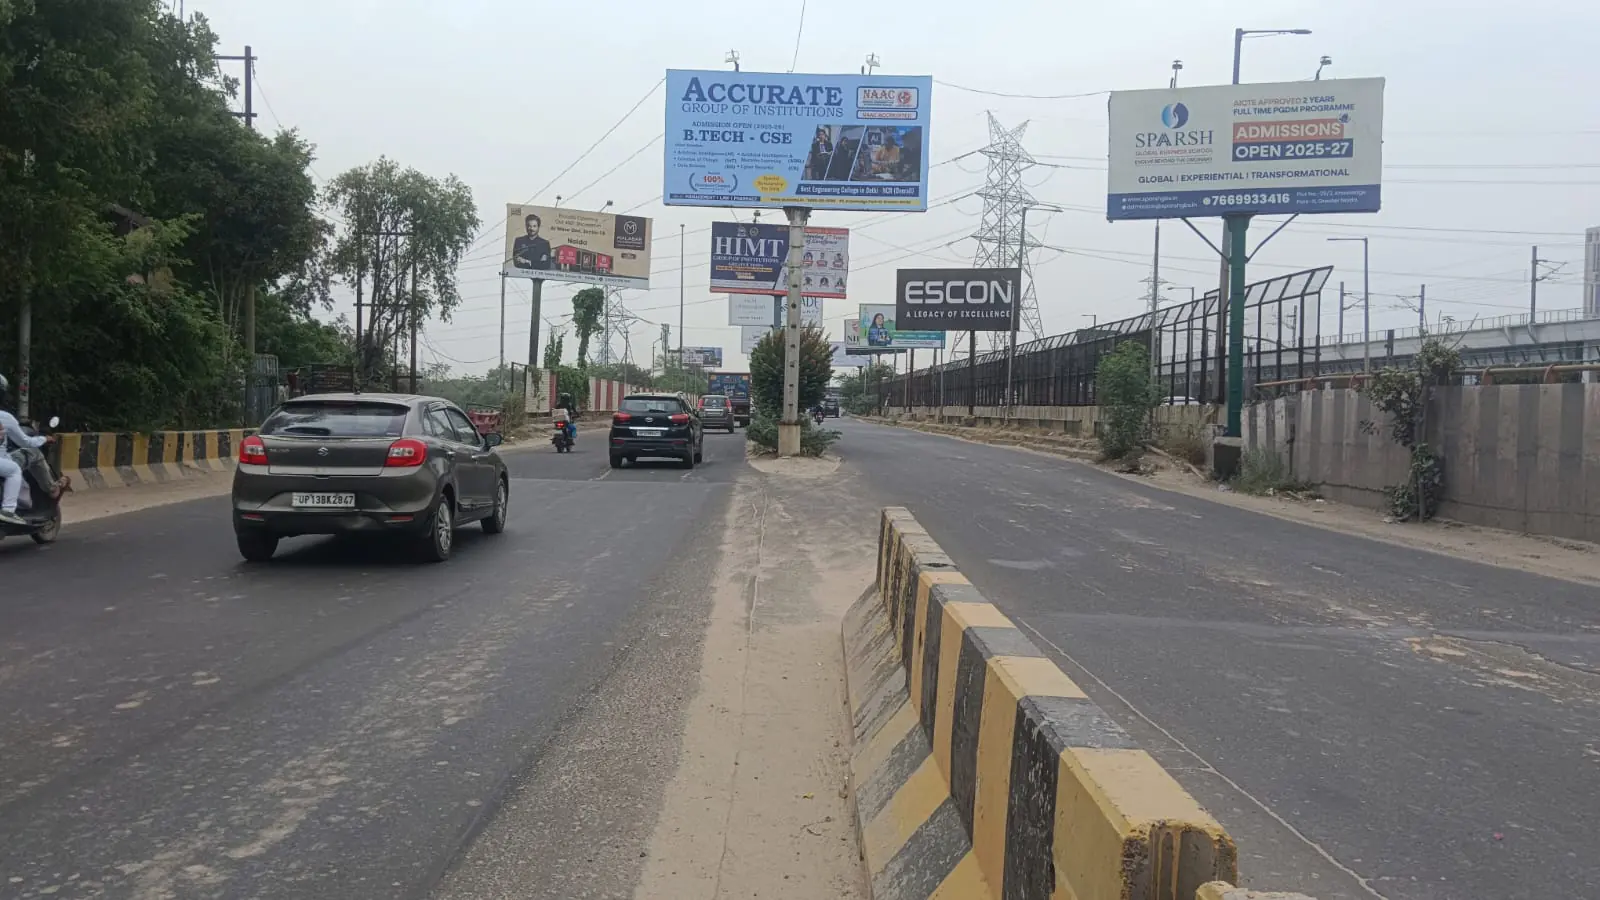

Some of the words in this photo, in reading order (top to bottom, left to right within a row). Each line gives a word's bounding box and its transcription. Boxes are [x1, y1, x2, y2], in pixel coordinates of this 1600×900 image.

[681, 77, 843, 106] ACCURATE
[863, 90, 896, 100] NAAC
[1258, 98, 1302, 106] APPROVED
[1310, 95, 1335, 104] YEARS
[682, 103, 728, 114] GROUP
[732, 104, 750, 115] OF
[754, 105, 844, 118] INSTITUTIONS
[1233, 108, 1252, 116] FULL
[1253, 107, 1272, 115] TIME
[1273, 106, 1299, 114] PGDM
[1300, 103, 1355, 113] PROGRAMME
[683, 129, 745, 142] B.TECH
[760, 131, 793, 145] CSE
[1236, 122, 1341, 139] ADMISSIONS
[1235, 144, 1282, 159] OPEN
[1285, 142, 1350, 157] 2025-27
[1138, 175, 1174, 184] GLOBAL
[1181, 171, 1244, 182] EXPERIENTIAL
[1251, 168, 1350, 180] TRANSFORMATIONAL
[812, 186, 840, 194] Engineering
[1210, 193, 1290, 207] 7669933416
[567, 237, 588, 246] Noida
[713, 236, 785, 258] HIMT
[905, 280, 1012, 304] ESCON
[905, 310, 911, 318] A
[914, 310, 945, 318] LEGACY
[960, 310, 1010, 319] EXCELLENCE
